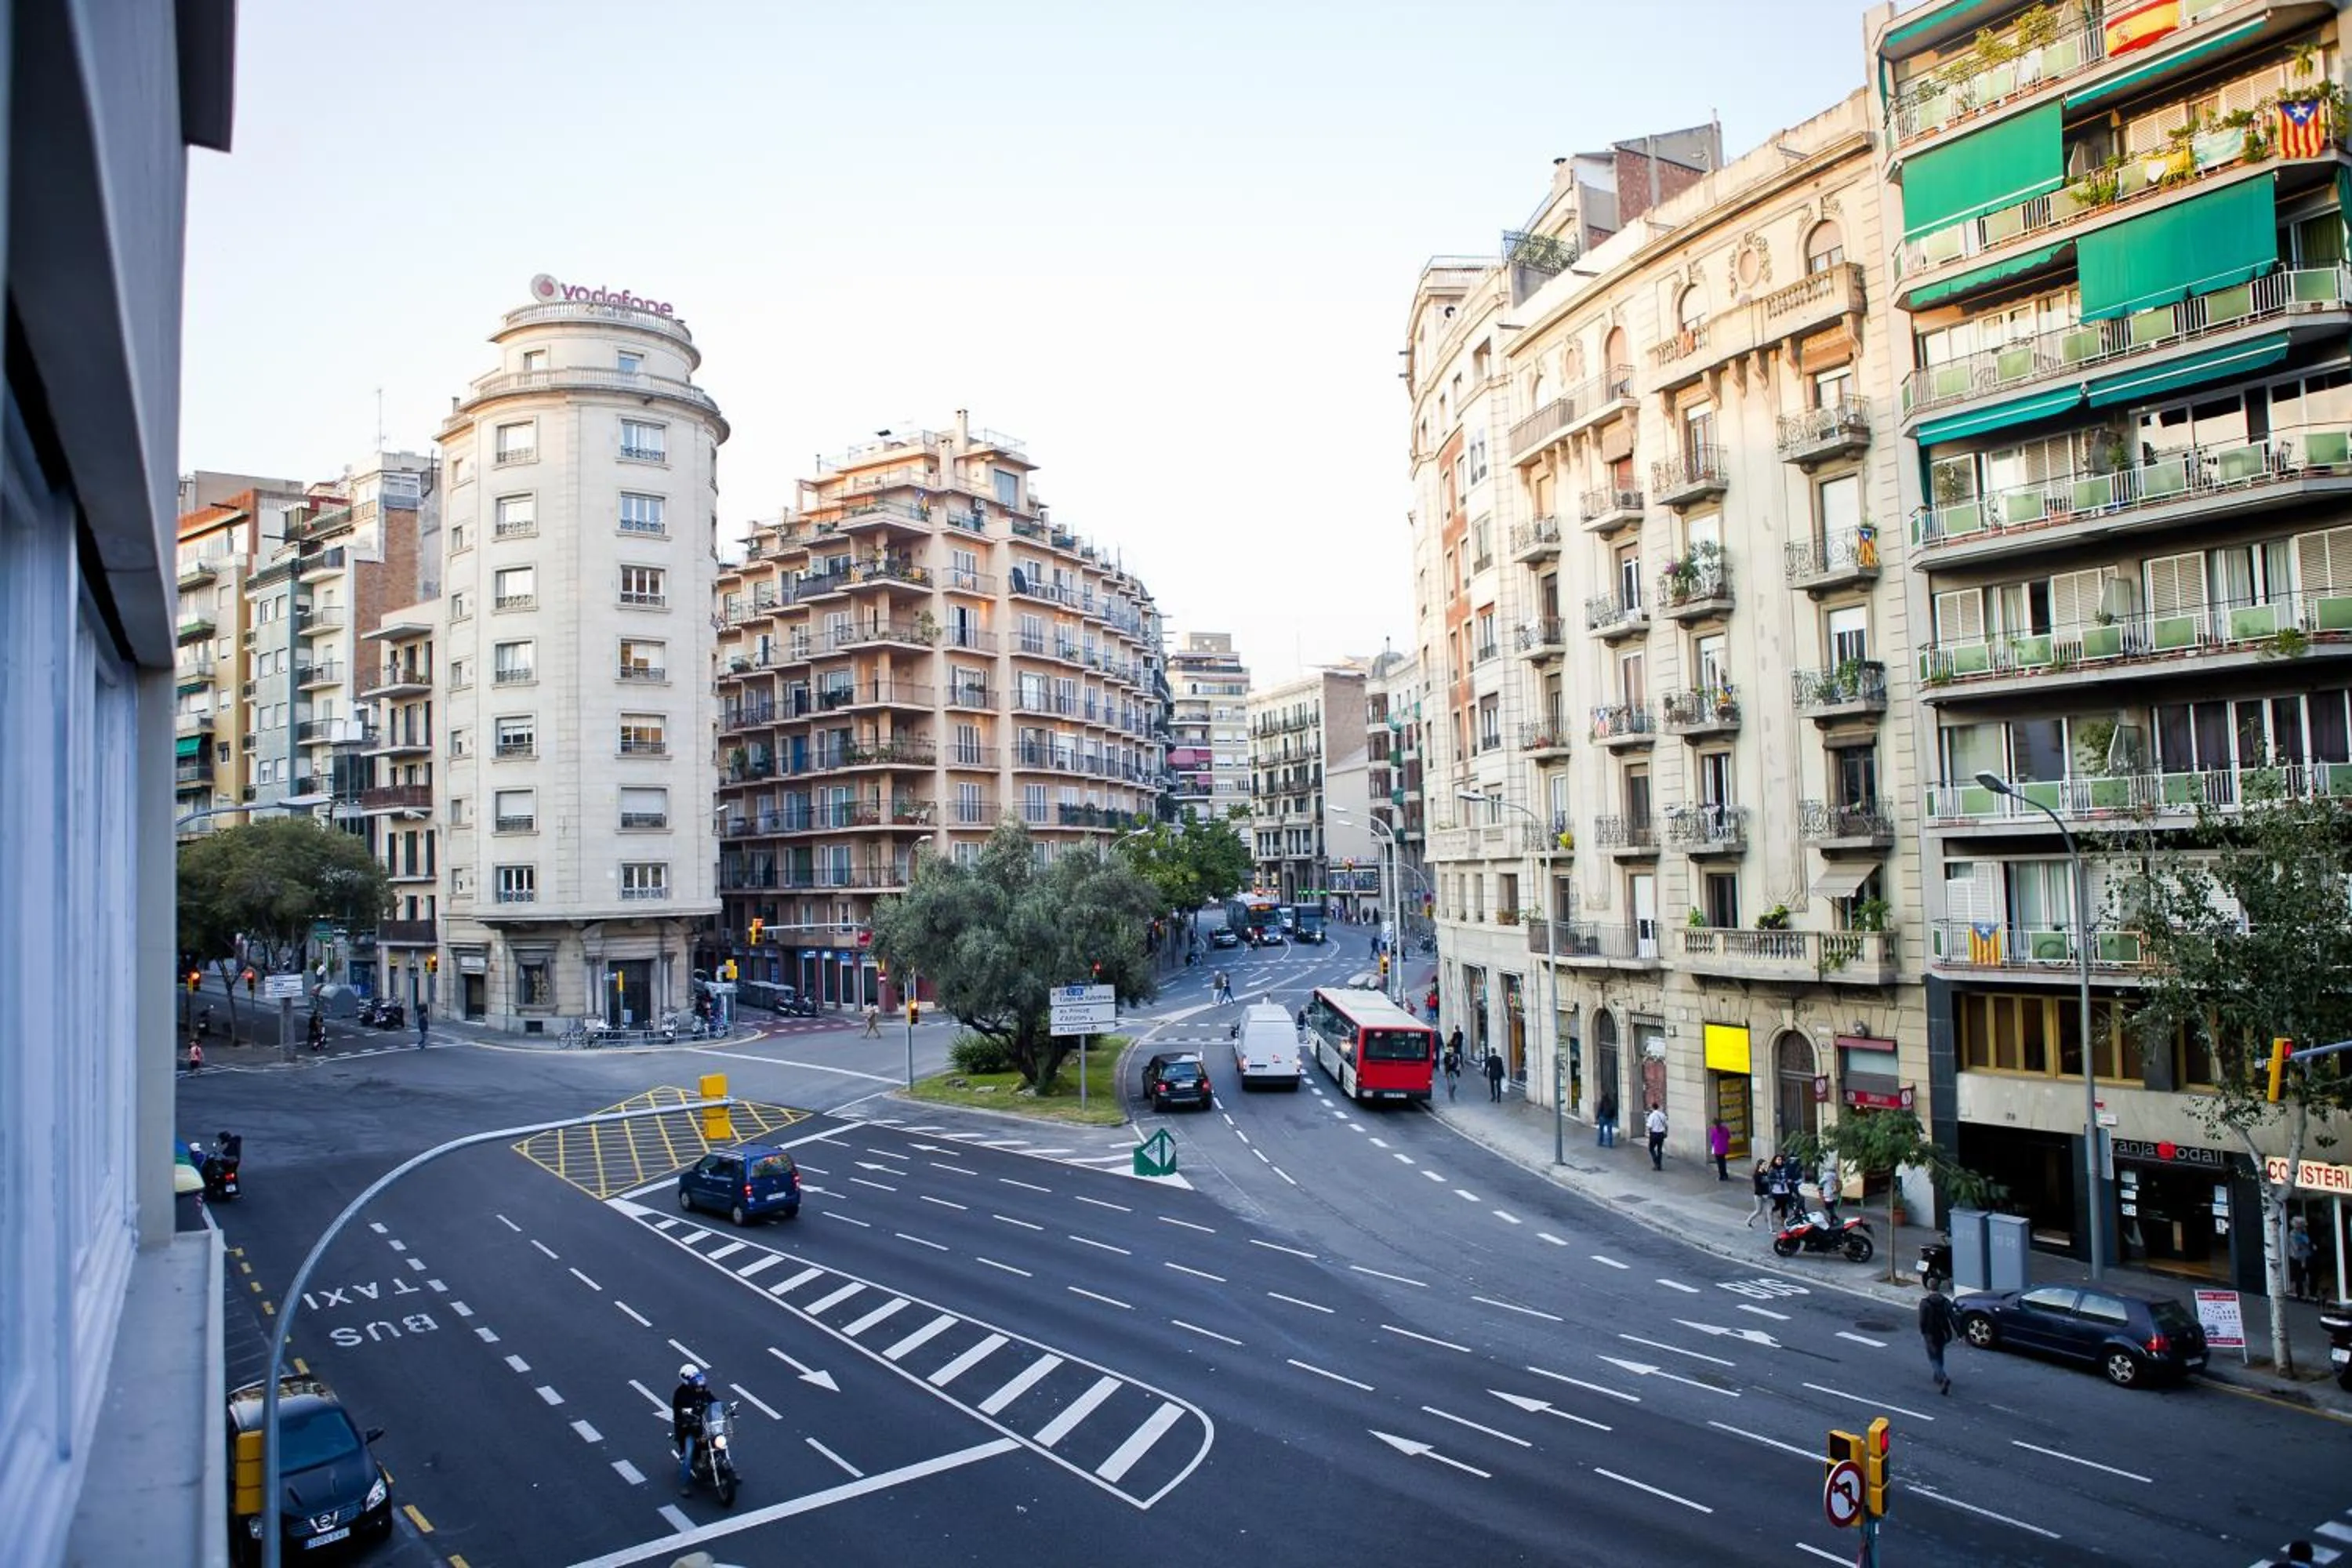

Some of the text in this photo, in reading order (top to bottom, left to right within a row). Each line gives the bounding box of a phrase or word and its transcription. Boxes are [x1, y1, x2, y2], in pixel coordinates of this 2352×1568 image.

[561, 282, 673, 318] vodafone
[2267, 1160, 2352, 1190] COISTERI
[303, 1278, 420, 1309] TAXI
[329, 1313, 439, 1347] BUS
